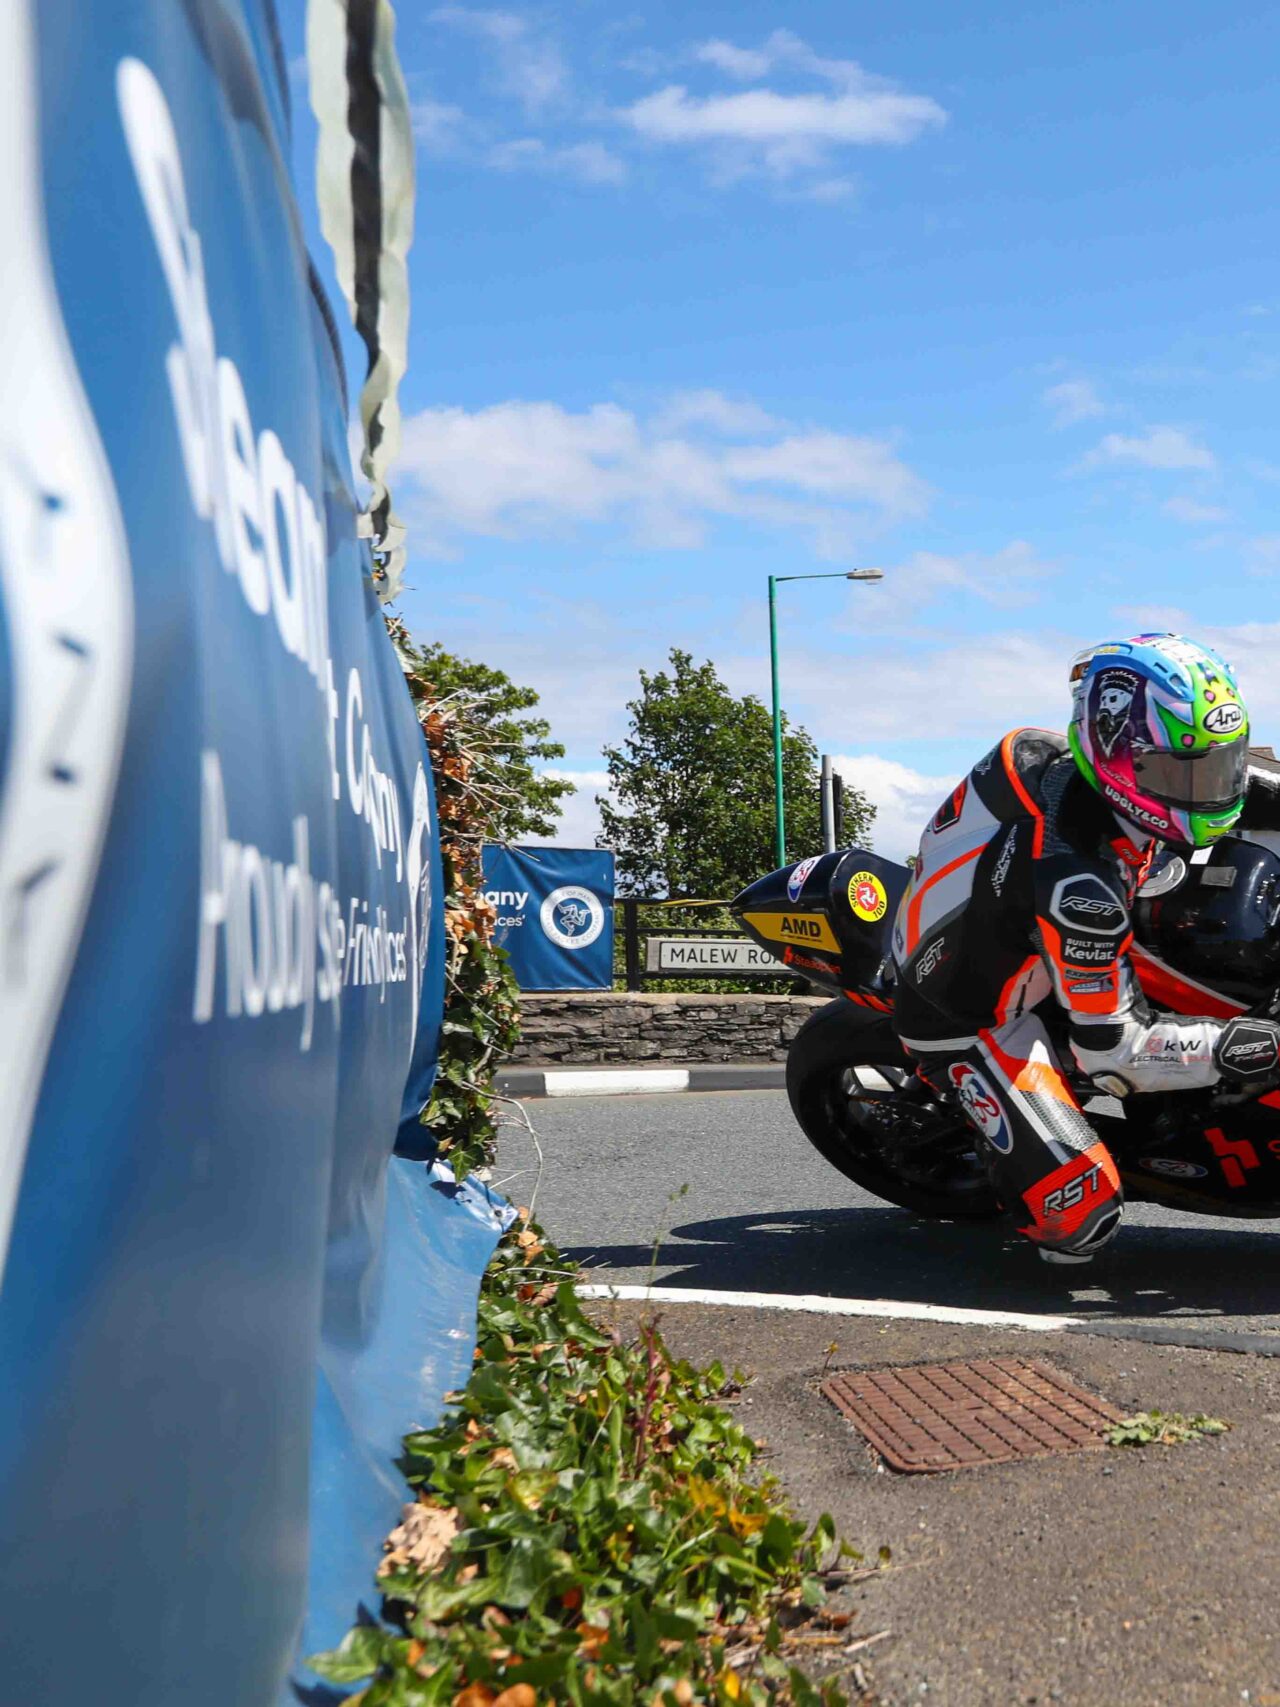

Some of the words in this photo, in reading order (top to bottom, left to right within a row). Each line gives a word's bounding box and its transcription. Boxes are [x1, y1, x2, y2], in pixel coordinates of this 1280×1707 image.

[852, 873, 874, 908] SOUTHERN
[872, 900, 886, 919] 100
[1060, 896, 1122, 916] RST
[780, 916, 822, 938] AMD
[1066, 938, 1092, 948] BUILT
[1093, 941, 1115, 949] WITH
[670, 948, 737, 964] MALEW
[916, 936, 945, 975] RST
[1225, 1040, 1271, 1057] RST
[1043, 1161, 1103, 1216] RST
